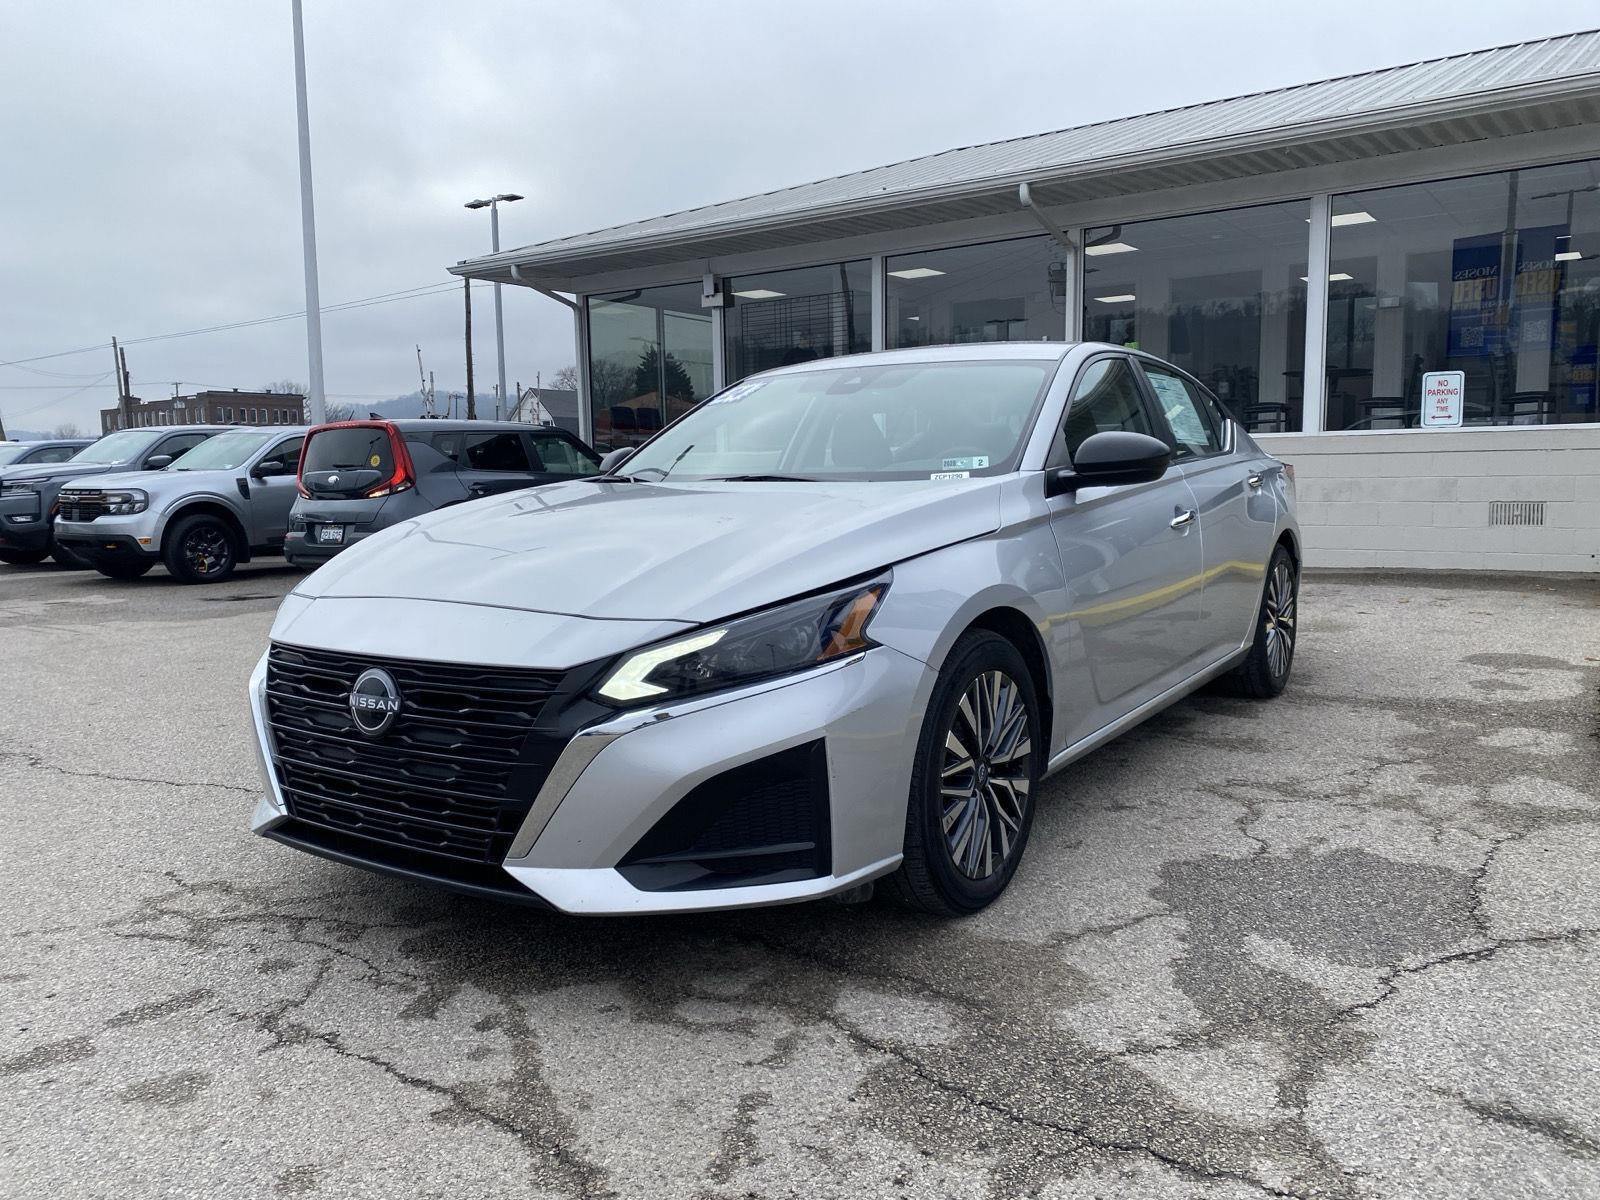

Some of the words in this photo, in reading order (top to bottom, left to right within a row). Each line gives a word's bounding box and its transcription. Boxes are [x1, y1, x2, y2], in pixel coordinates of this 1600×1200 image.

[1437, 379, 1449, 387] NO
[1427, 388, 1459, 396] PARKING
[349, 694, 398, 711] NISSAN
